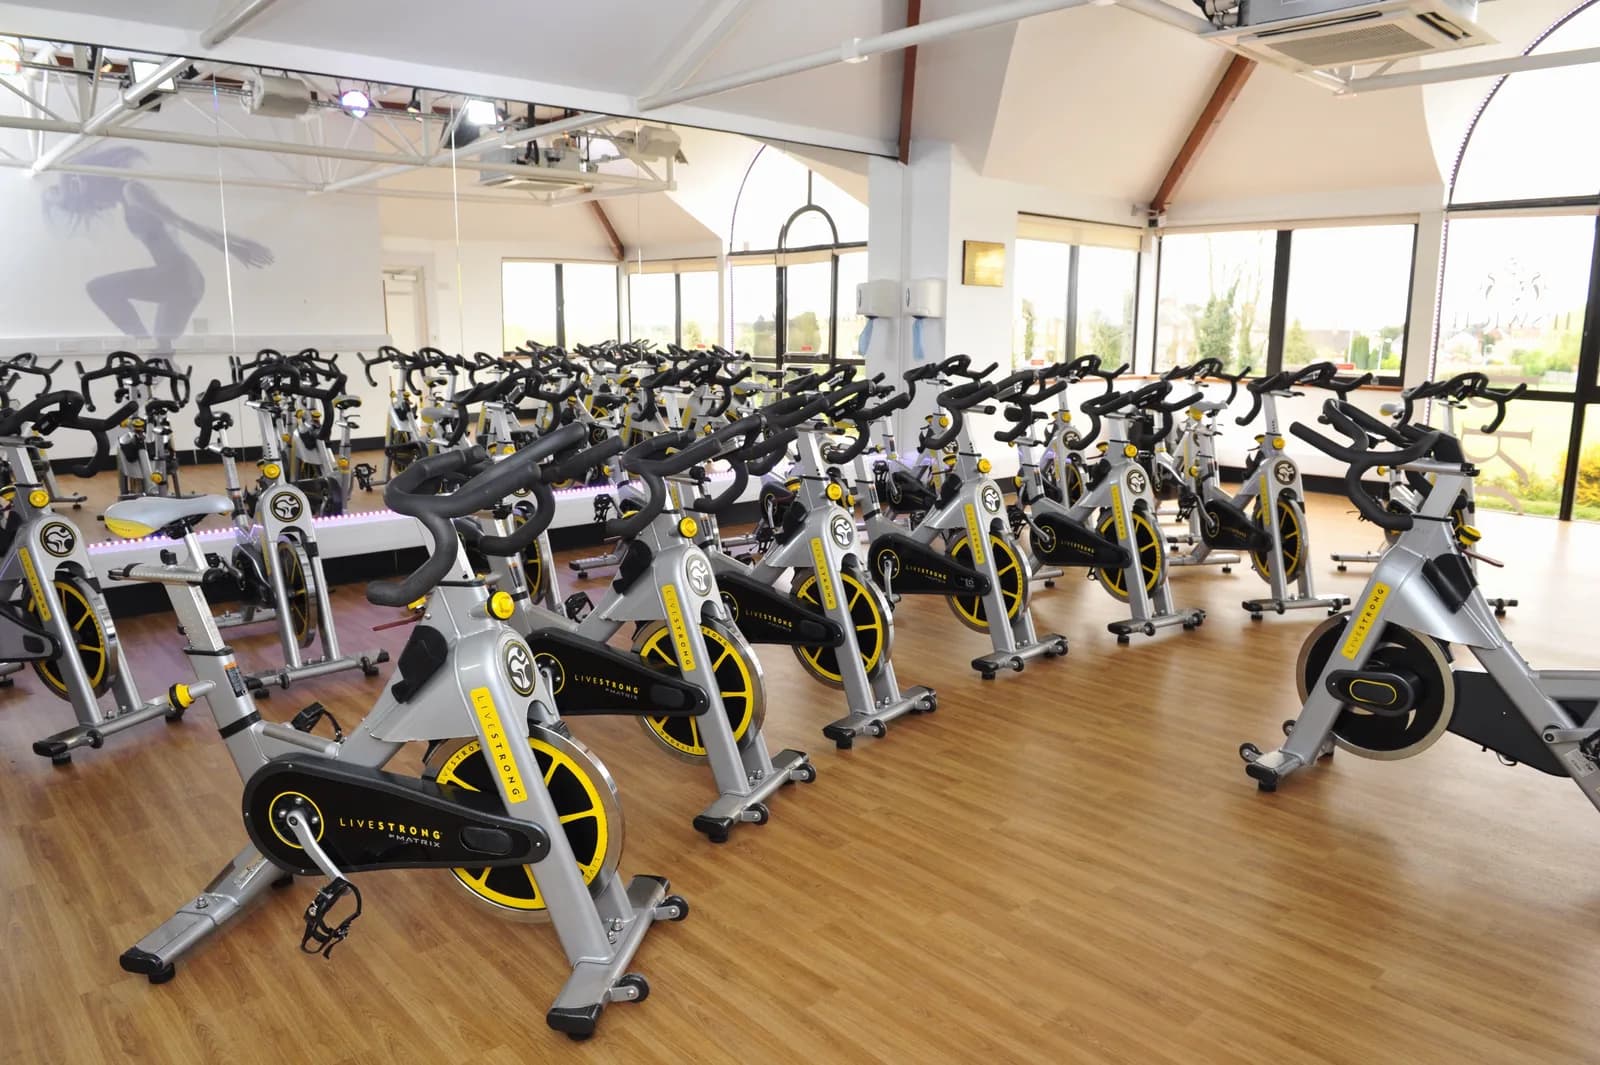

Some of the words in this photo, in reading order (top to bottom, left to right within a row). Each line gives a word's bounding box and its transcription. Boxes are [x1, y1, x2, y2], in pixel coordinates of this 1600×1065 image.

[665, 590, 691, 666] LIVESTRONG
[1348, 588, 1385, 654] LIVESTRONG
[574, 674, 638, 694] LIVESTRONG
[477, 695, 520, 796] LIVESTRONG
[340, 817, 440, 840] LIVESTRONG
[396, 835, 440, 848] MATRIX
